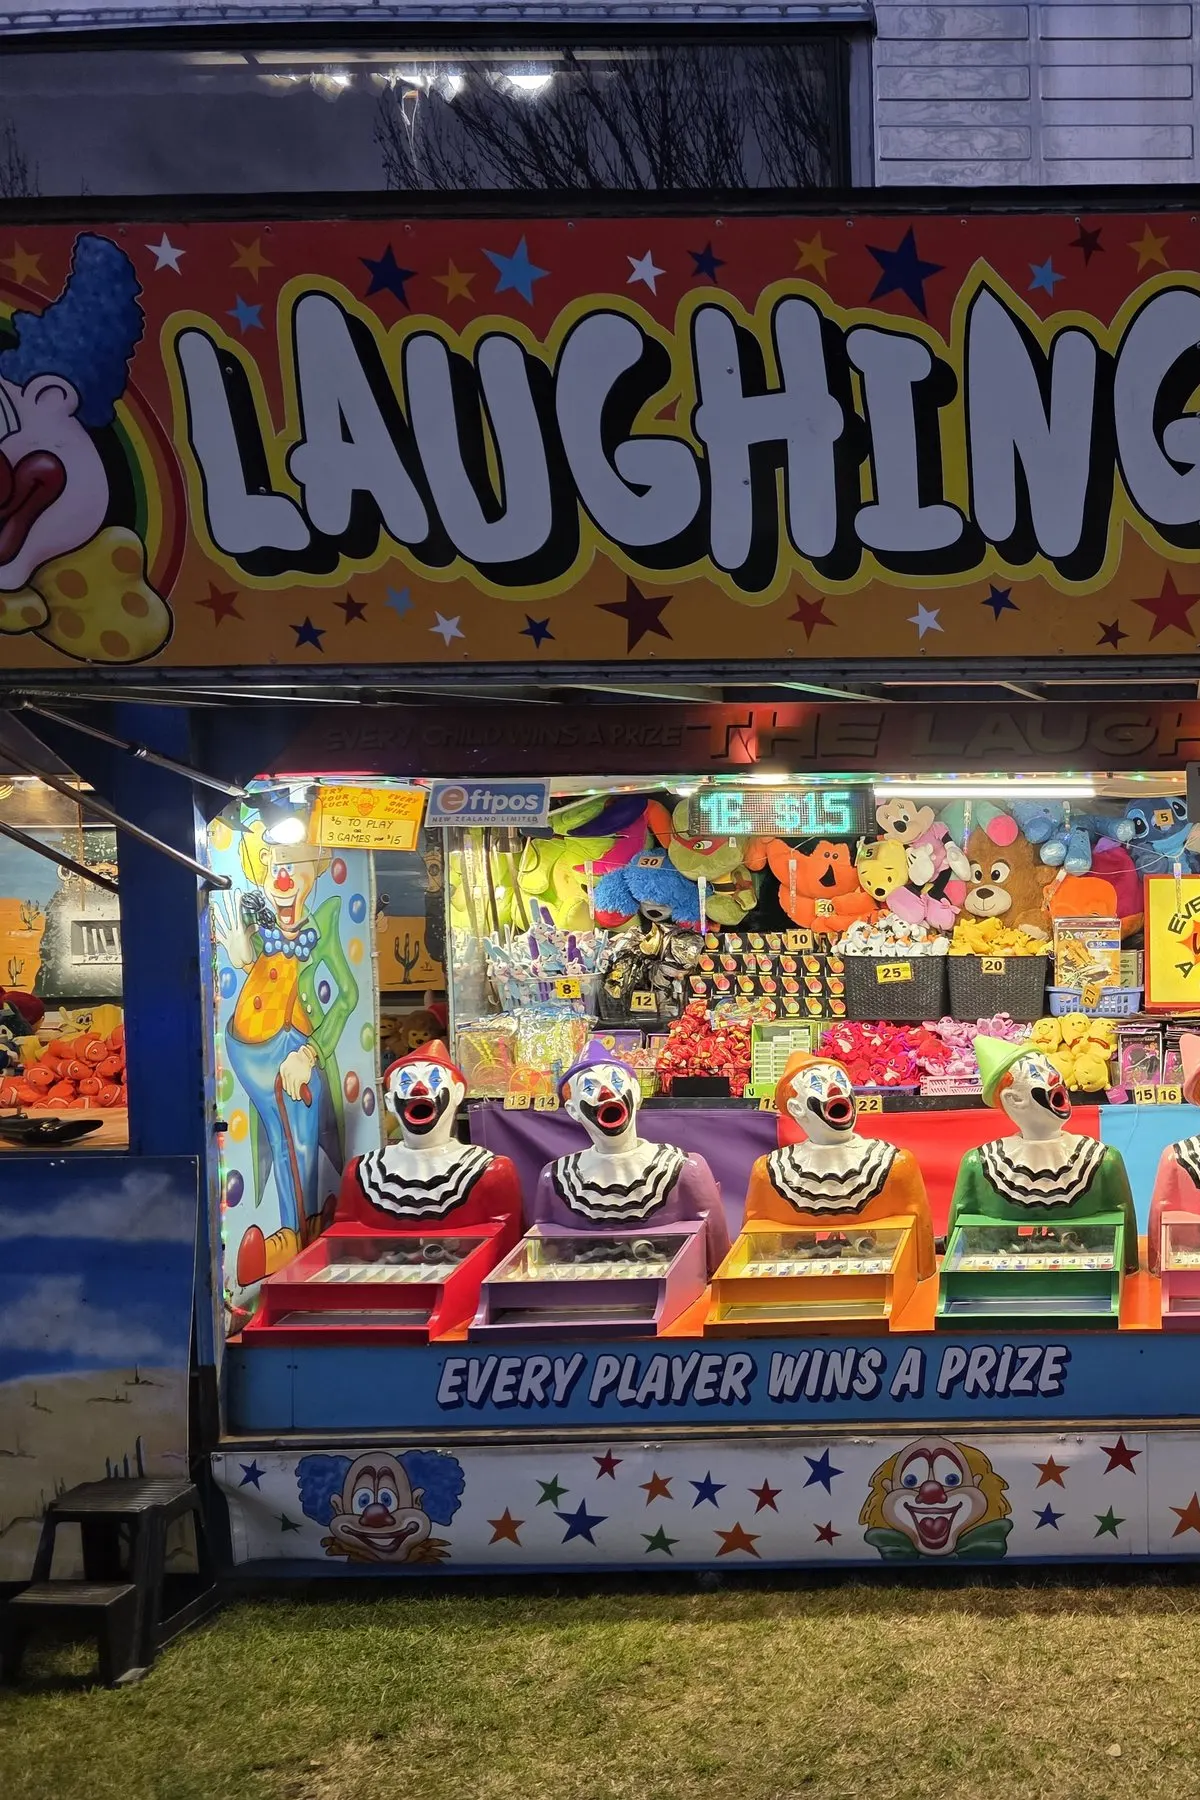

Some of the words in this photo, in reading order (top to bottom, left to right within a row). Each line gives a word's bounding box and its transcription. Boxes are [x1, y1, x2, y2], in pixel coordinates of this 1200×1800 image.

[325, 725, 411, 752] EVERY
[423, 723, 501, 749] CHILD
[506, 722, 581, 748] WINS
[582, 722, 604, 747] A
[606, 721, 686, 747] PRIZE
[686, 710, 888, 760] THE
[323, 787, 344, 795] TRY
[387, 793, 418, 804] EVERY
[437, 786, 539, 814] eftpos
[322, 801, 350, 809] LUCK
[389, 801, 409, 809] ONE
[384, 807, 411, 816] WINS
[775, 792, 851, 833] $15
[331, 816, 342, 825] $6
[348, 818, 361, 827] TO
[366, 819, 394, 829] PLAY
[1160, 813, 1169, 822] 5
[327, 832, 334, 841] 3
[337, 832, 371, 843] GAMES
[387, 834, 402, 845] $15
[866, 848, 873, 857] 5
[640, 858, 659, 866] 30
[819, 902, 834, 913] 30
[791, 934, 808, 944] 10
[984, 960, 1003, 971] 20
[1174, 961, 1195, 979] A
[882, 967, 901, 979] 25
[562, 983, 572, 994] 8
[635, 996, 652, 1006] 12
[1083, 988, 1096, 1005] 27
[509, 1095, 526, 1106] 13
[1136, 1089, 1153, 1101] 15
[1160, 1090, 1177, 1101] 16
[539, 1096, 556, 1107] 14
[858, 1099, 879, 1111] 22
[435, 1351, 587, 1409] EVERY
[589, 1350, 757, 1407] PLAYER
[766, 1347, 887, 1403] WINS
[889, 1347, 921, 1400] A
[935, 1344, 1073, 1398] PRIZE
